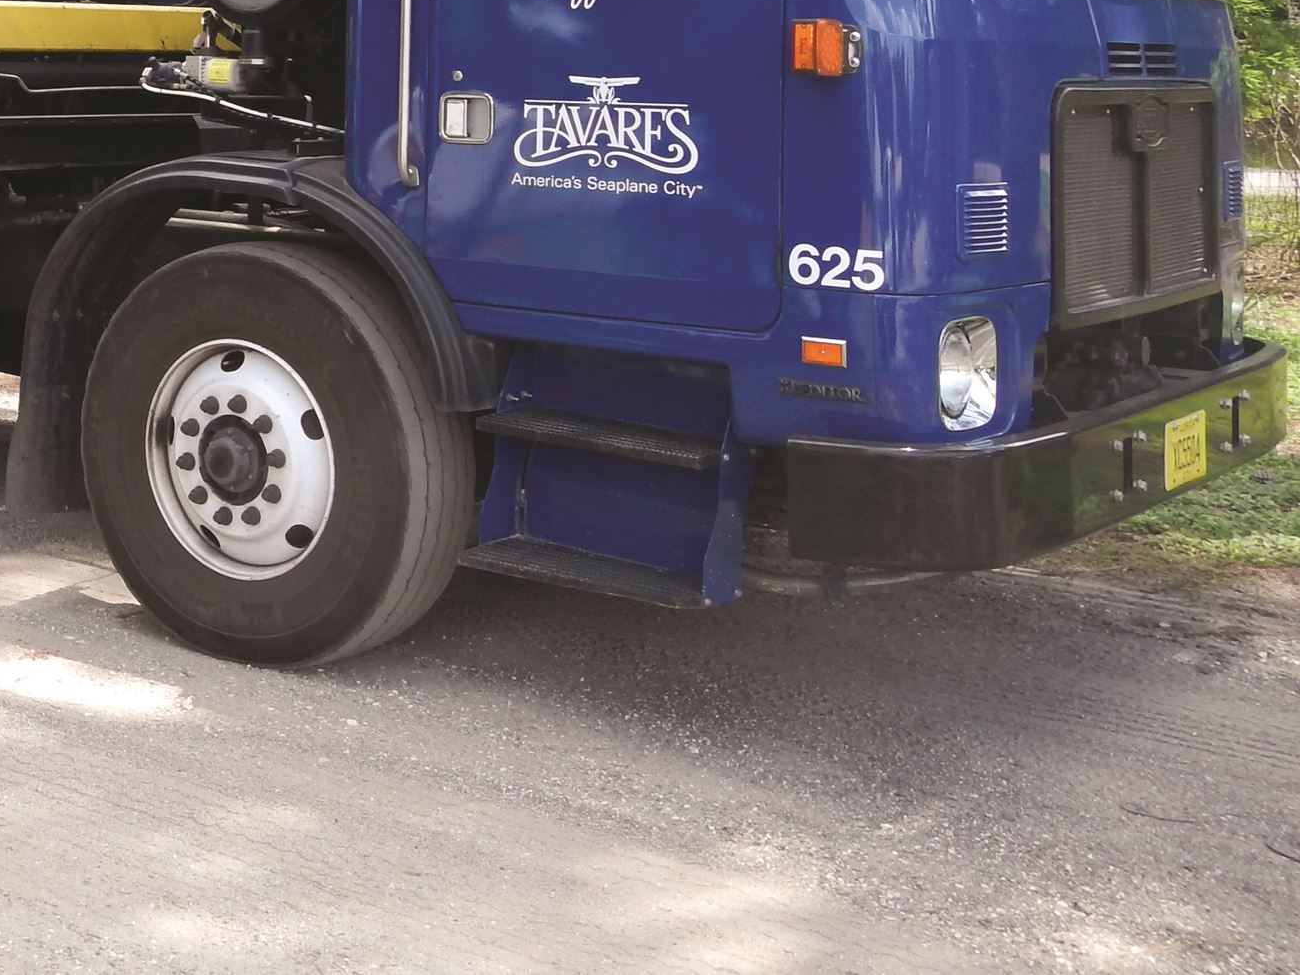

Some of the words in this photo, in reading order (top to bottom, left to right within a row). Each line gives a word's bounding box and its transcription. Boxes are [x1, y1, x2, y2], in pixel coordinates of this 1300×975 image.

[514, 103, 698, 174] TAVARES
[511, 172, 582, 190] America's
[586, 177, 658, 194] Seaplane
[788, 243, 885, 291] 625
